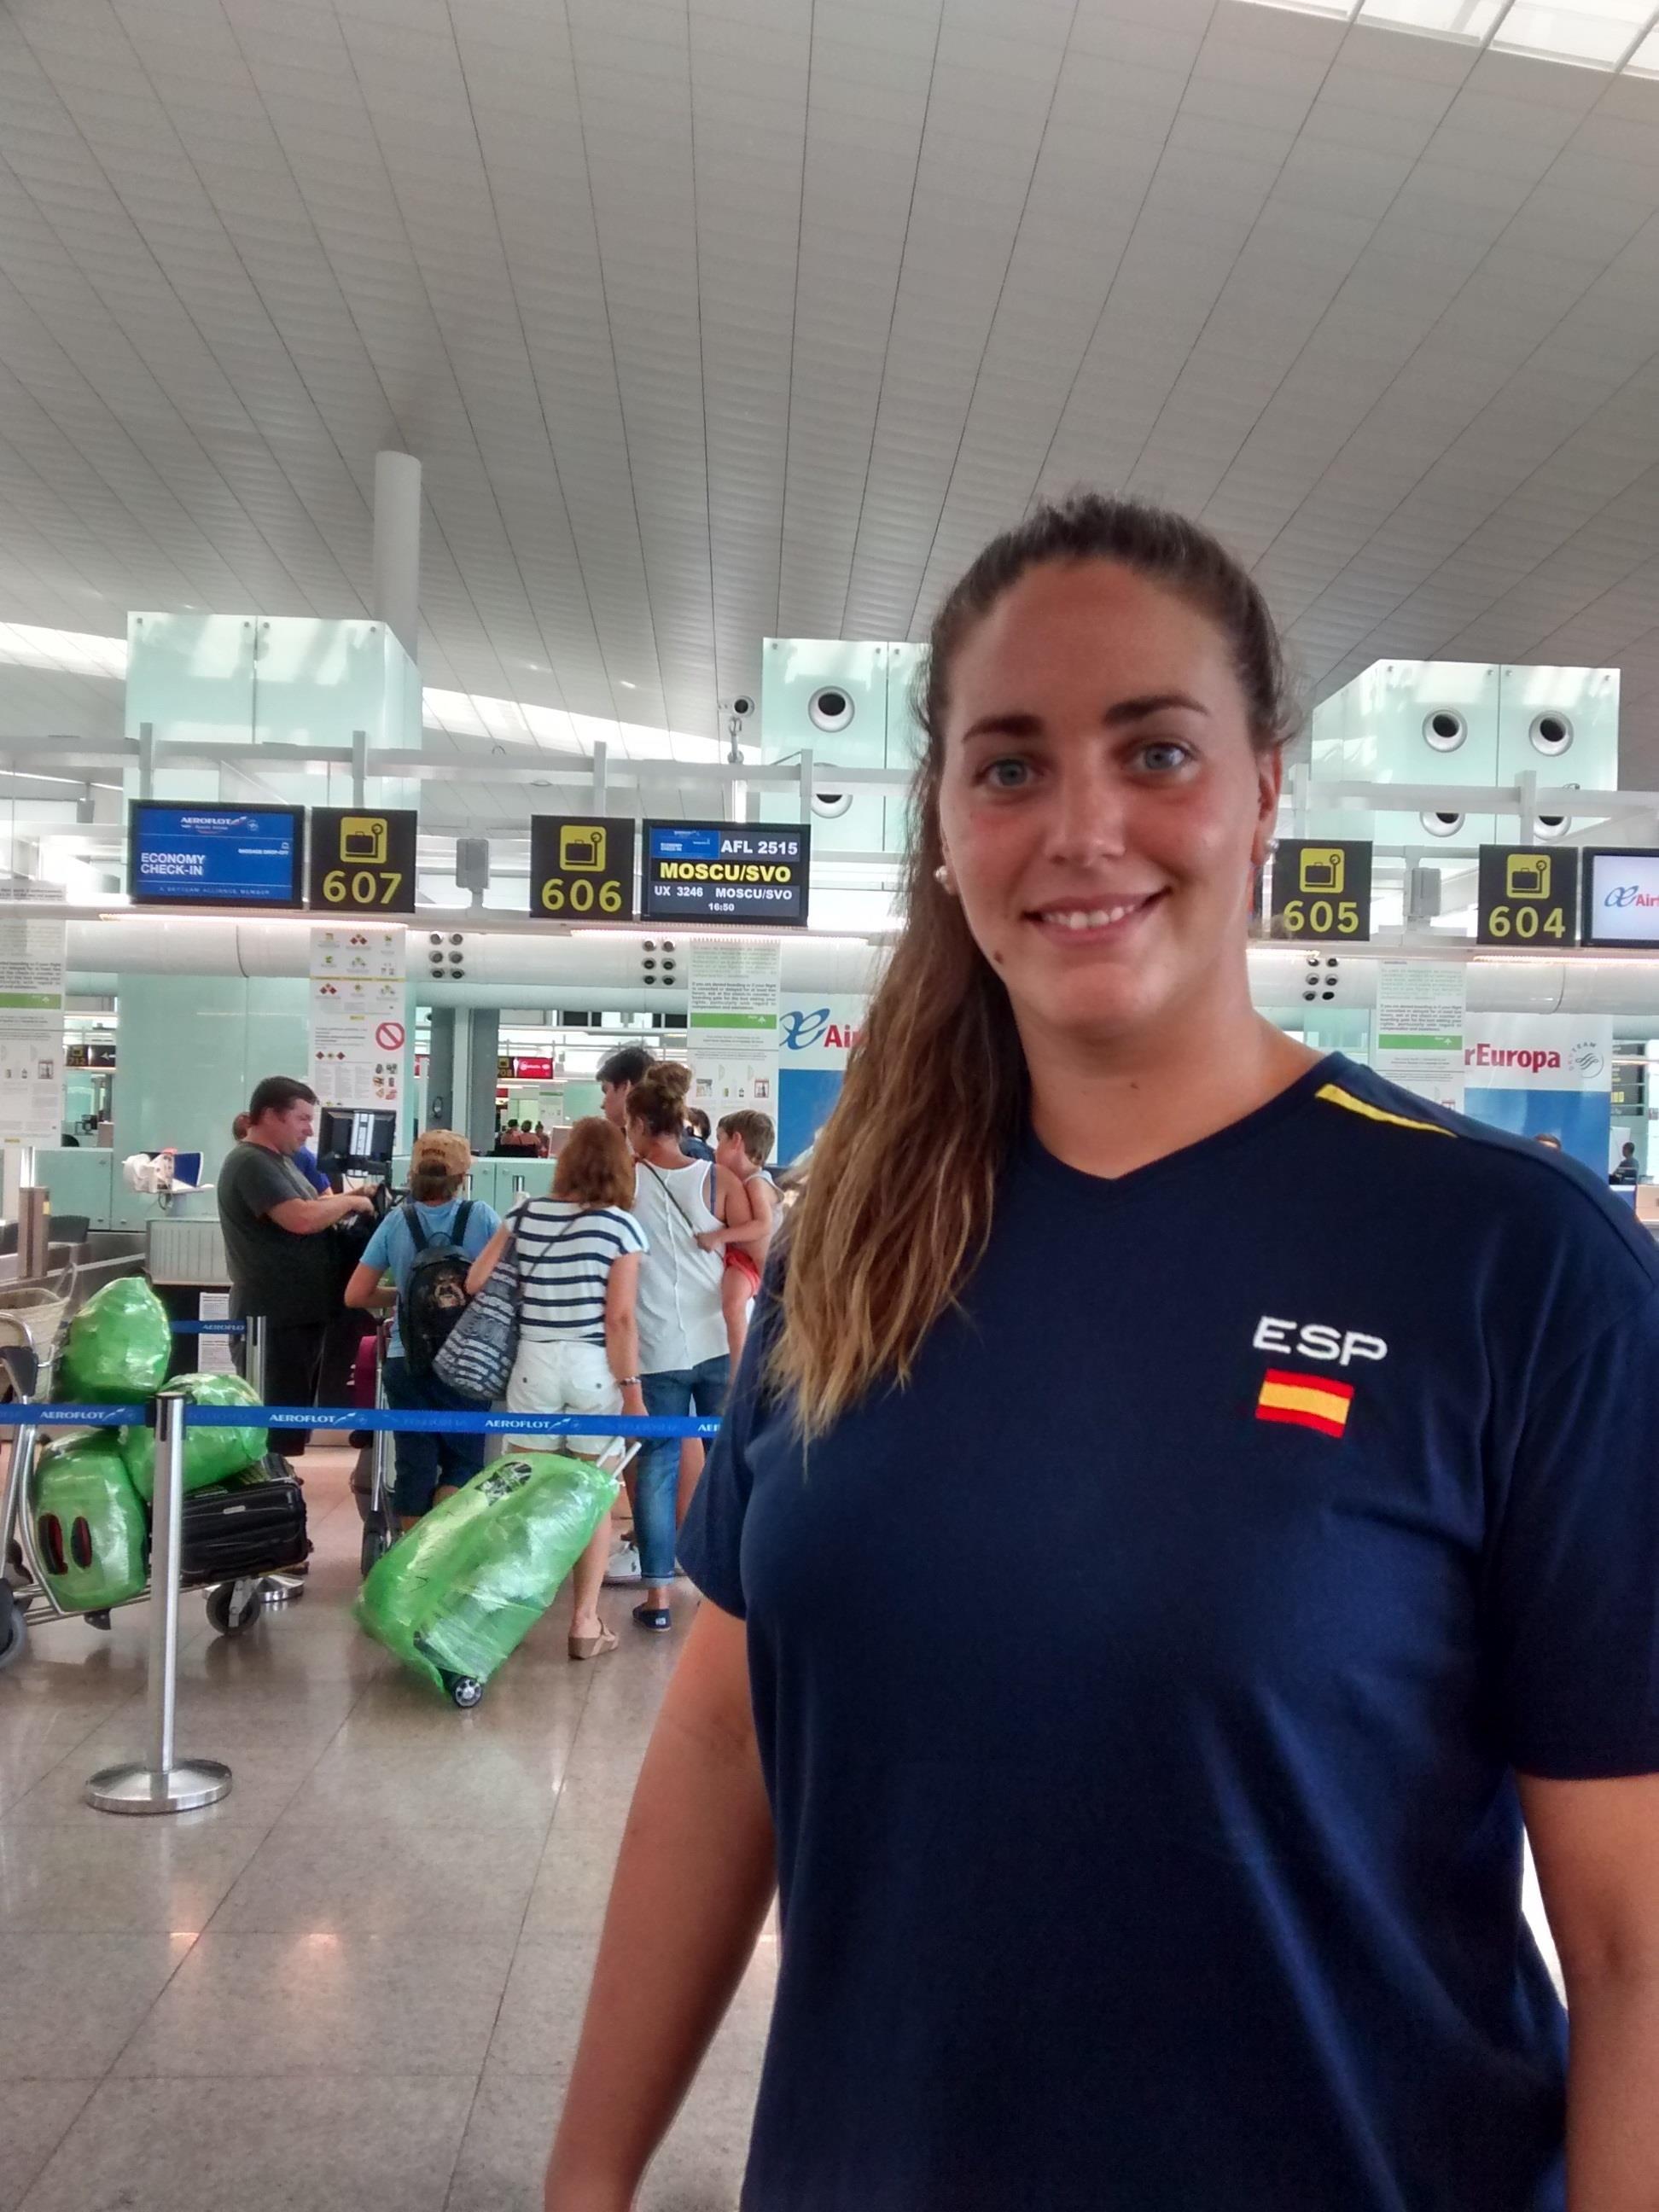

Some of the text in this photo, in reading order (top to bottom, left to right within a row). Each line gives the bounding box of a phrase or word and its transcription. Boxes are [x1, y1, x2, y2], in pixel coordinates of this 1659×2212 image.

[721, 841, 797, 854] AFL 2515
[141, 853, 206, 864] ECONOMY
[141, 864, 204, 876] CHECK-IN
[660, 862, 791, 882] MOSCU/SVO
[323, 870, 402, 905] 607
[655, 886, 792, 899] UX 3246 MOSCU/SVO
[542, 878, 622, 912] 606
[1636, 894, 1659, 907] Air
[708, 903, 735, 911] 16:50
[1283, 900, 1359, 933] 605
[1489, 905, 1566, 939] 604
[1464, 1043, 1561, 1074] rEuropa
[1252, 1315, 1388, 1366] ESP
[40, 1411, 104, 1419] AEROFLOT
[269, 1413, 335, 1423] AEROFLOT
[485, 1419, 550, 1429] AEROFLOT
